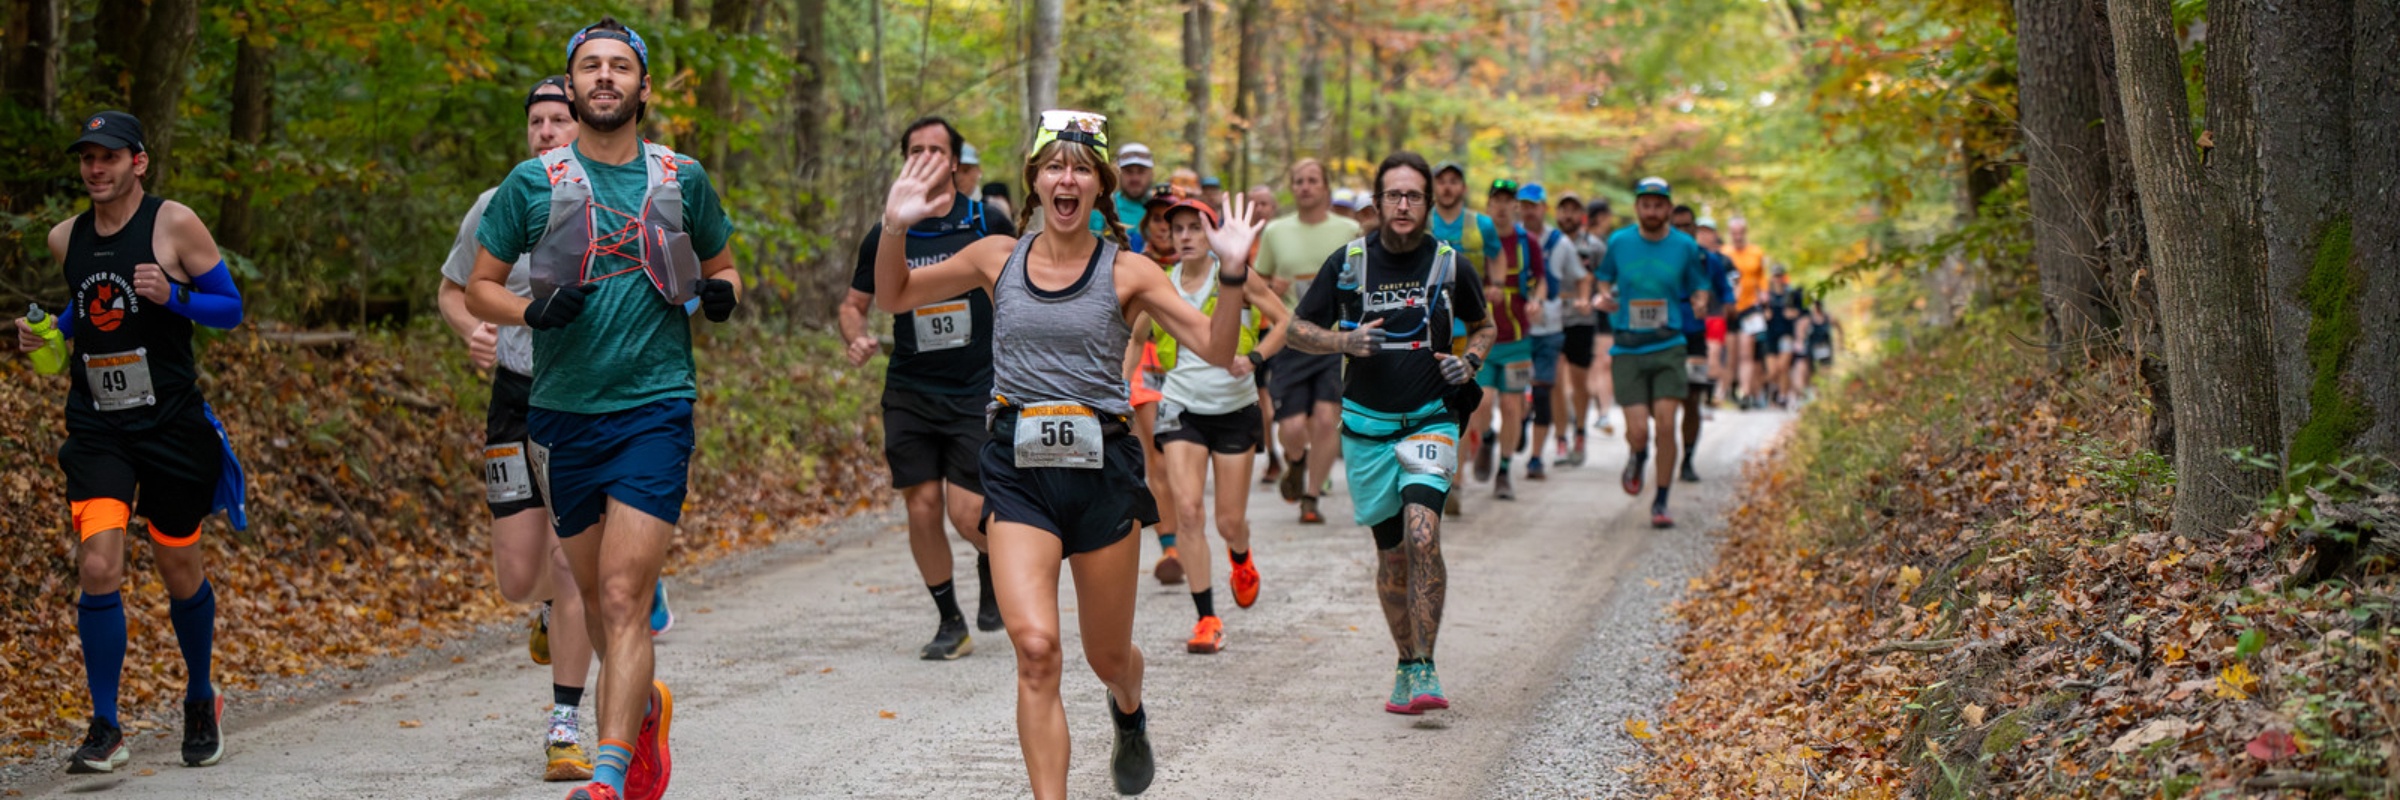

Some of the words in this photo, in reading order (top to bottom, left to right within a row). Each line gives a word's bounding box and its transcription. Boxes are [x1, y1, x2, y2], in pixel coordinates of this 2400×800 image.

[81, 272, 108, 290] RIVER
[109, 272, 139, 313] RUNNING
[77, 291, 86, 318] WILD
[931, 315, 955, 335] 93
[102, 370, 128, 392] 49
[1041, 421, 1075, 446] 56
[1416, 443, 1438, 460] 16
